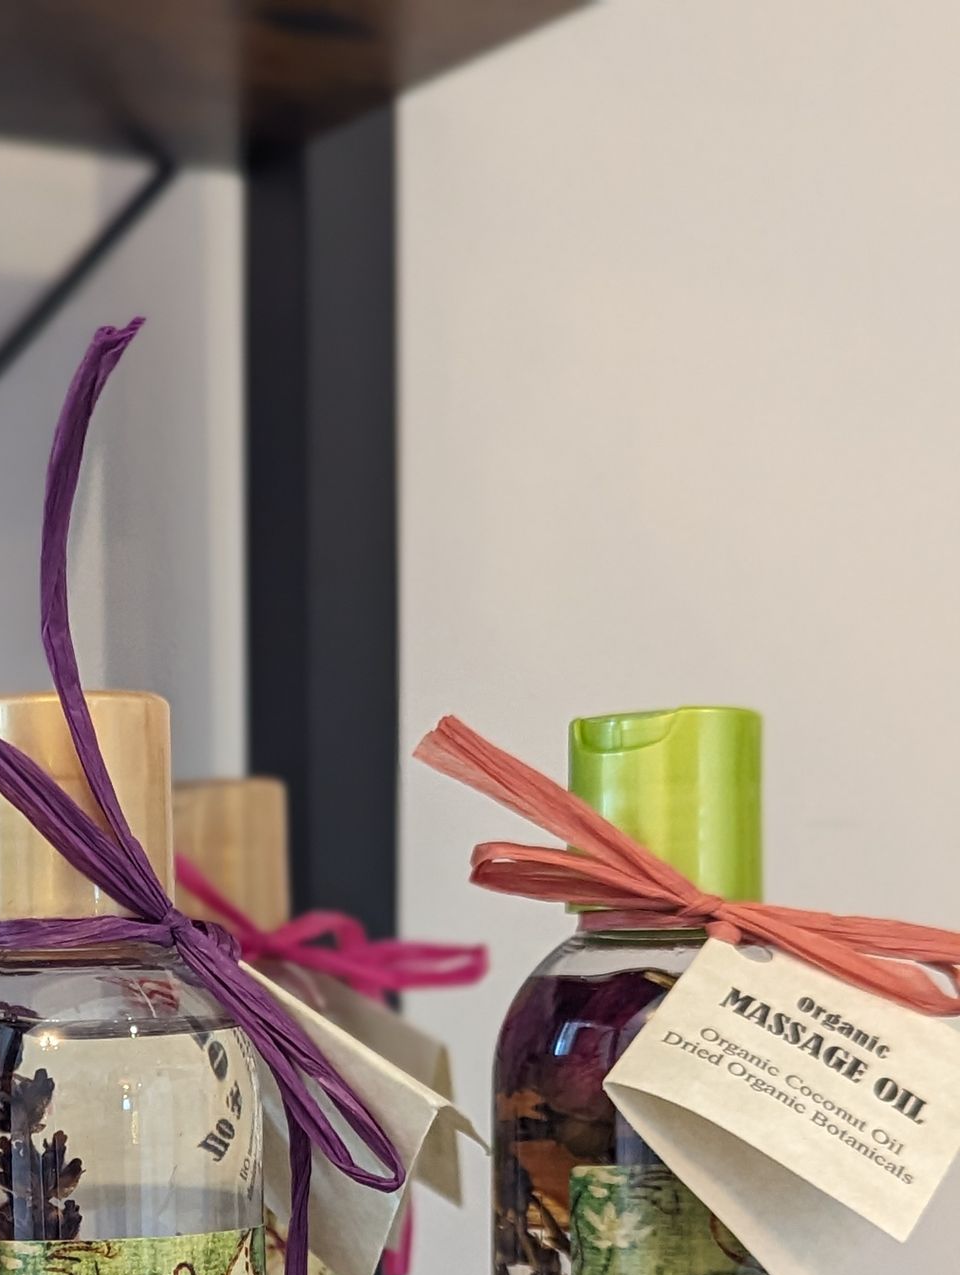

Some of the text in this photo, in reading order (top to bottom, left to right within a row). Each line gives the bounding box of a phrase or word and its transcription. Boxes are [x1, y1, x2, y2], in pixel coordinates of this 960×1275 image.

[700, 1027, 905, 1156] Organic Coconut Oil
[719, 986, 928, 1126] MASSAGE OIL
[796, 995, 891, 1060] Organic
[661, 1030, 915, 1186] Dried Organic Botanicals
